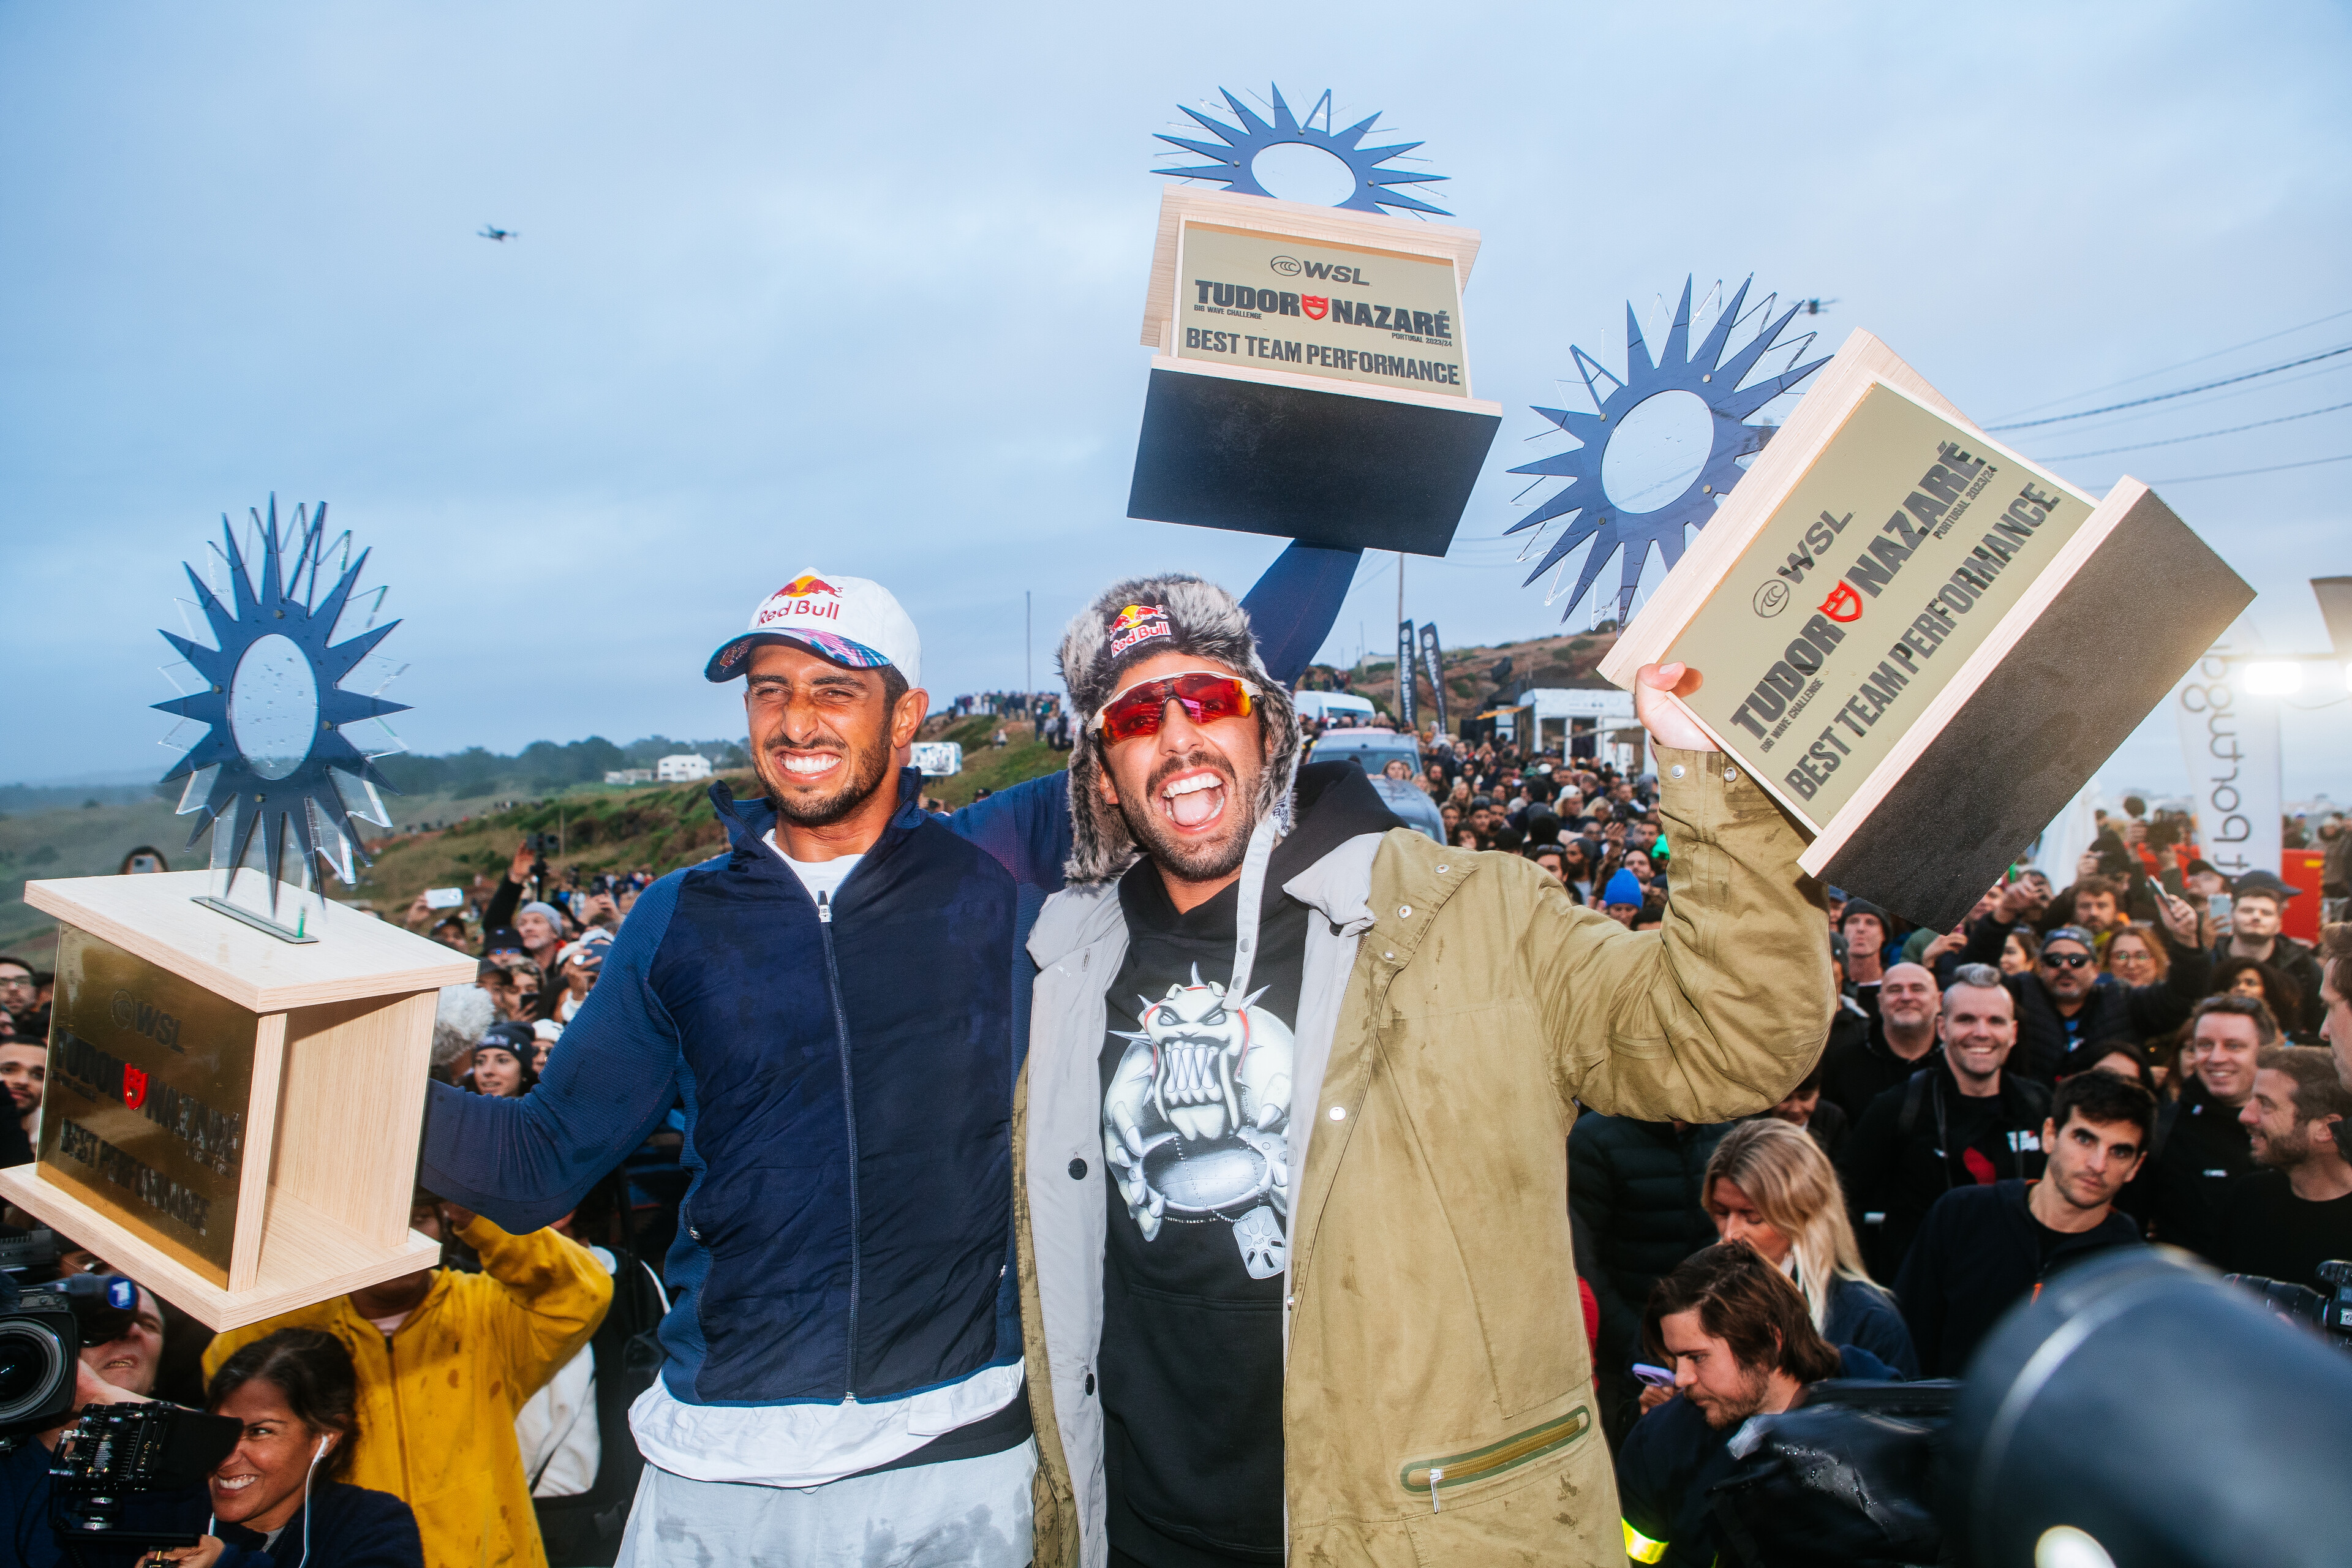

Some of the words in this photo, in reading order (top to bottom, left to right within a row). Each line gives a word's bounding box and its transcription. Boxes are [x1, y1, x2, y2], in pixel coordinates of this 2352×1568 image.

[1303, 261, 1370, 286] WSL
[1194, 279, 1300, 317] TUDOR
[1332, 298, 1452, 339] NAZARÉ
[1207, 306, 1225, 314] WAVE
[1227, 309, 1262, 320] CHALLENGE
[1186, 326, 1240, 354] BEST
[1245, 335, 1302, 363] TEAM
[1307, 344, 1460, 385] PERFORMANCE
[1392, 332, 1424, 343] PORTUGAL
[1425, 337, 1453, 347] 2023/24
[1932, 500, 1970, 539] PORTUGAL
[1776, 510, 1853, 584] WSL
[756, 600, 793, 628] Red
[794, 600, 840, 620] Bull
[1730, 614, 1845, 739] TUDOR
[1845, 440, 1986, 597] NAZARÉ
[1111, 630, 1137, 657] Red
[1137, 622, 1170, 639] Bull
[1784, 726, 1850, 801] BEST
[1833, 661, 1909, 737] TEAM
[1888, 482, 2060, 674] PERFORMANCE
[1760, 737, 1775, 753] BIG
[1770, 717, 1792, 739] WAVE
[1788, 677, 1824, 718] CHALLENGE
